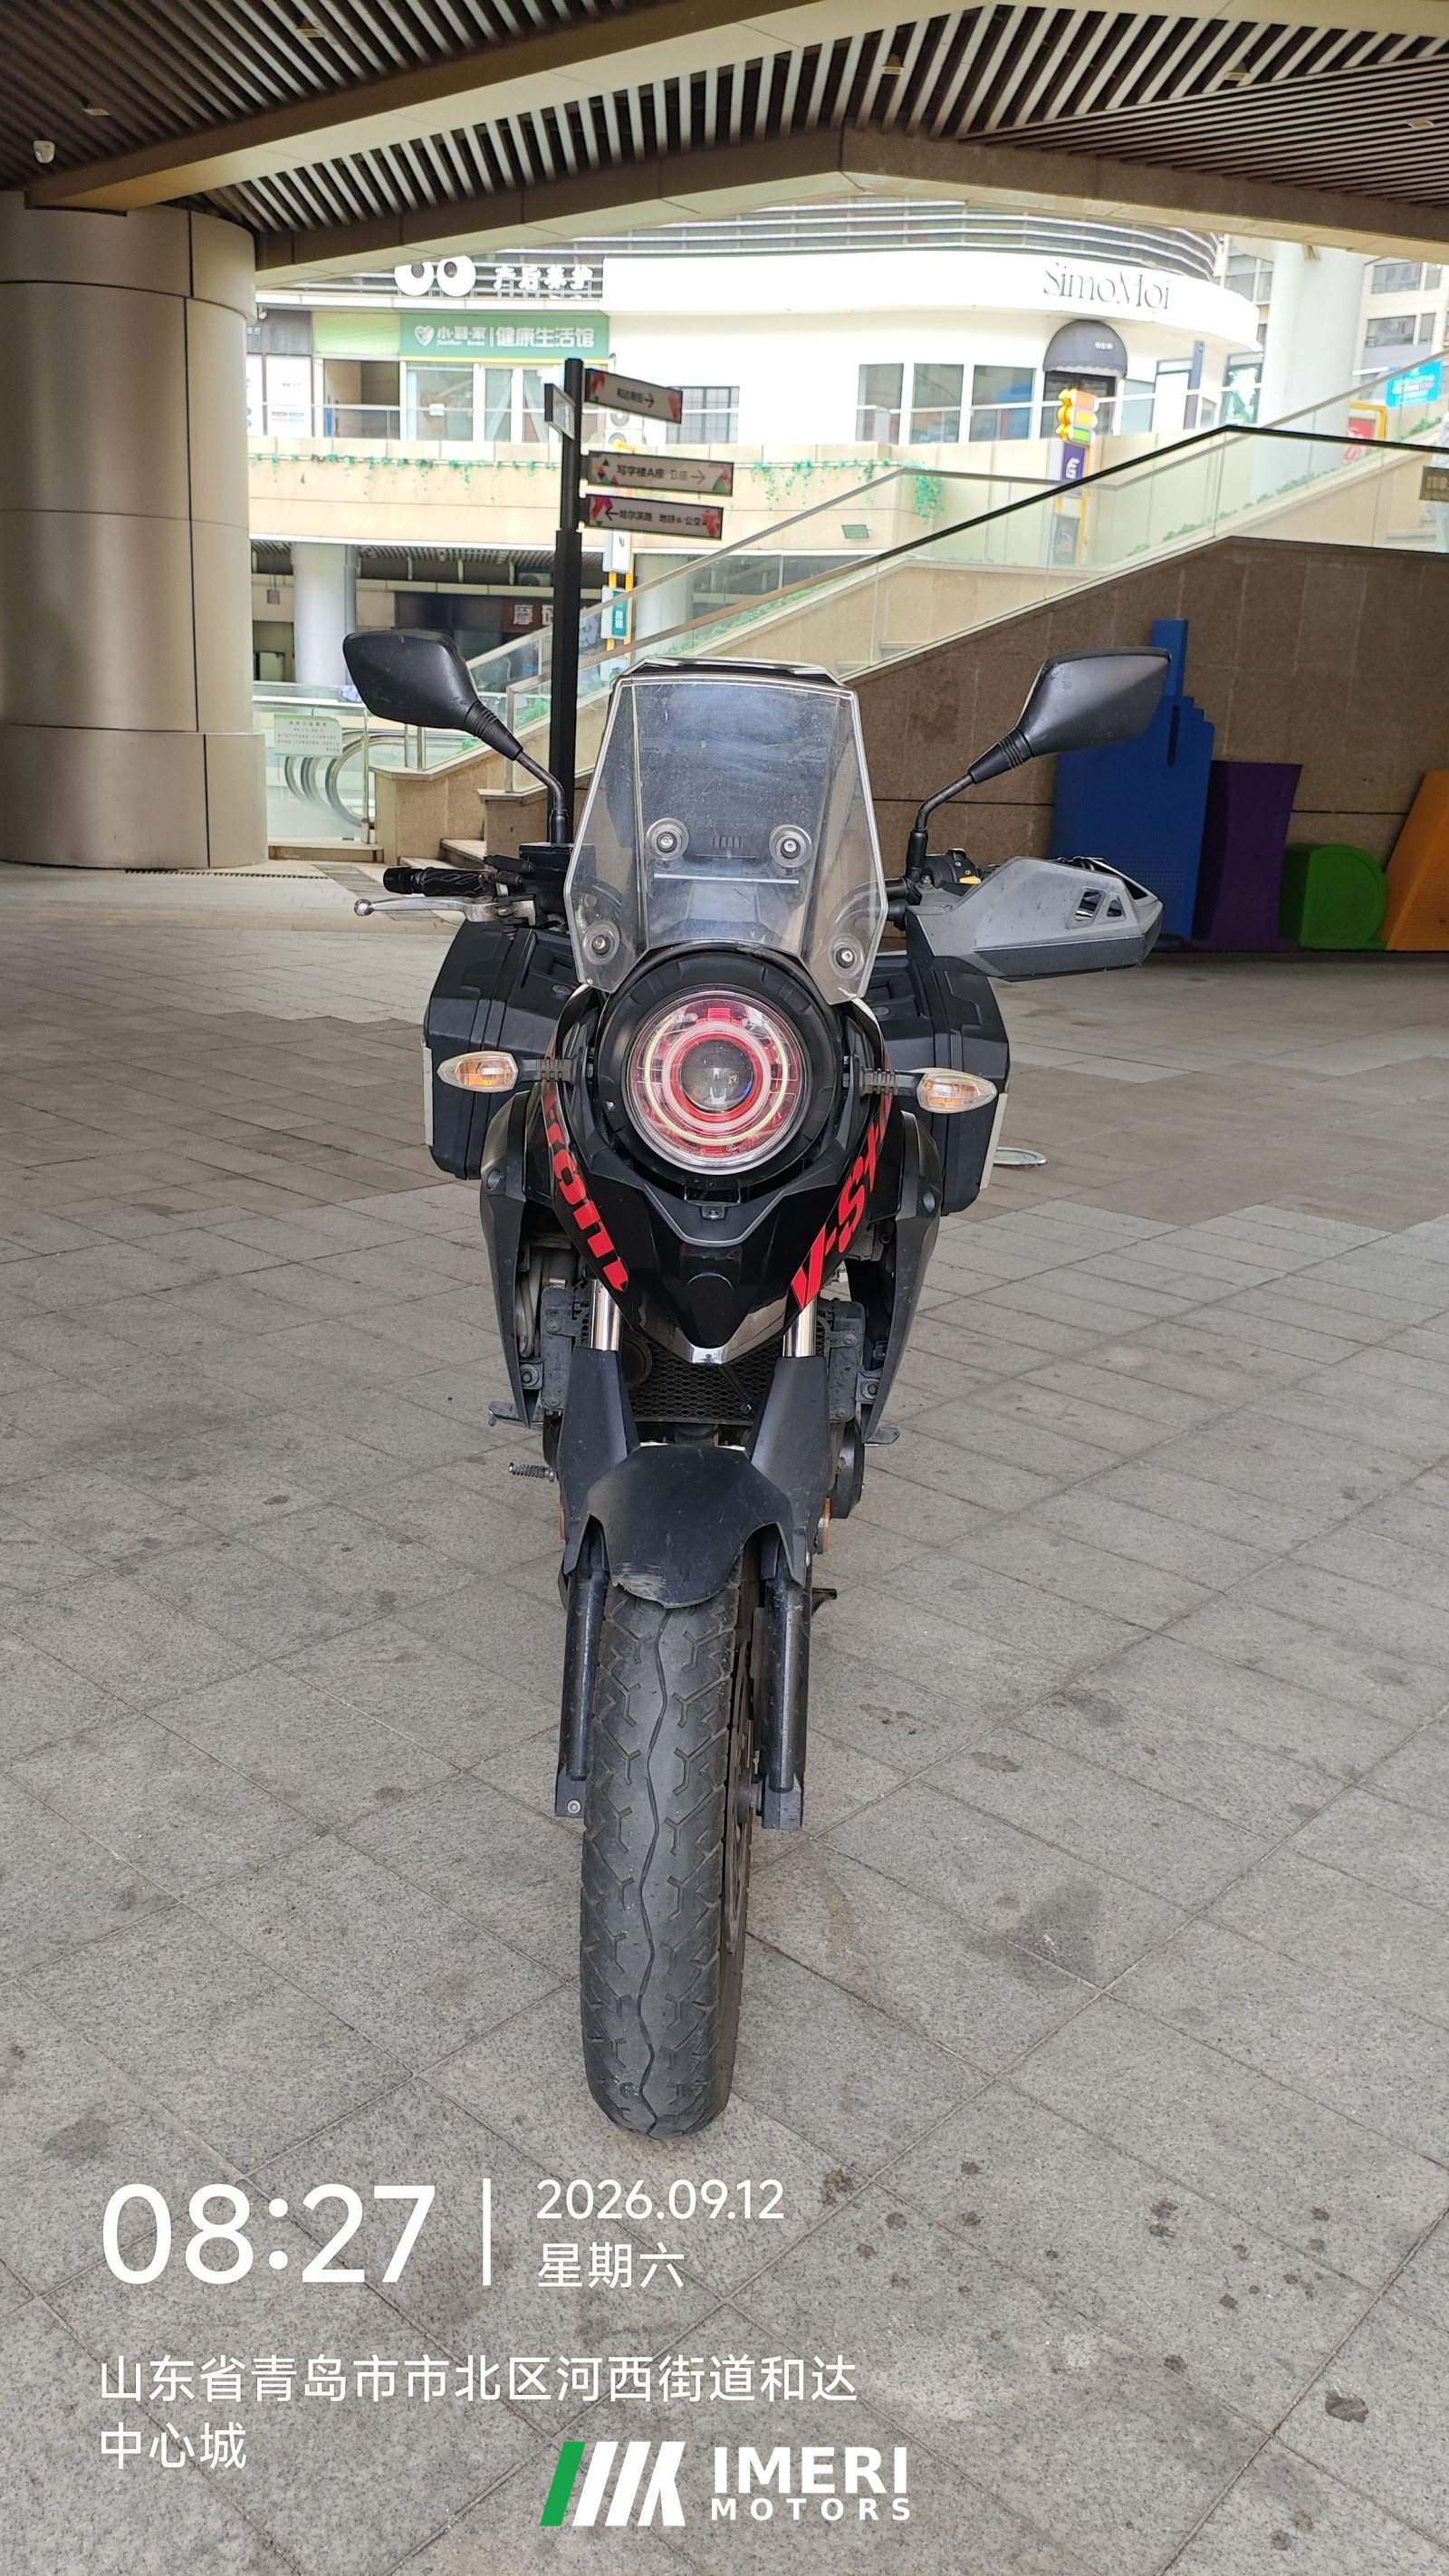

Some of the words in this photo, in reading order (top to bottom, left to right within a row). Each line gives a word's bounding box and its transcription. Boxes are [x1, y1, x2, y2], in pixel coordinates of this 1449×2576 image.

[496, 326, 595, 348] 健康生活馆
